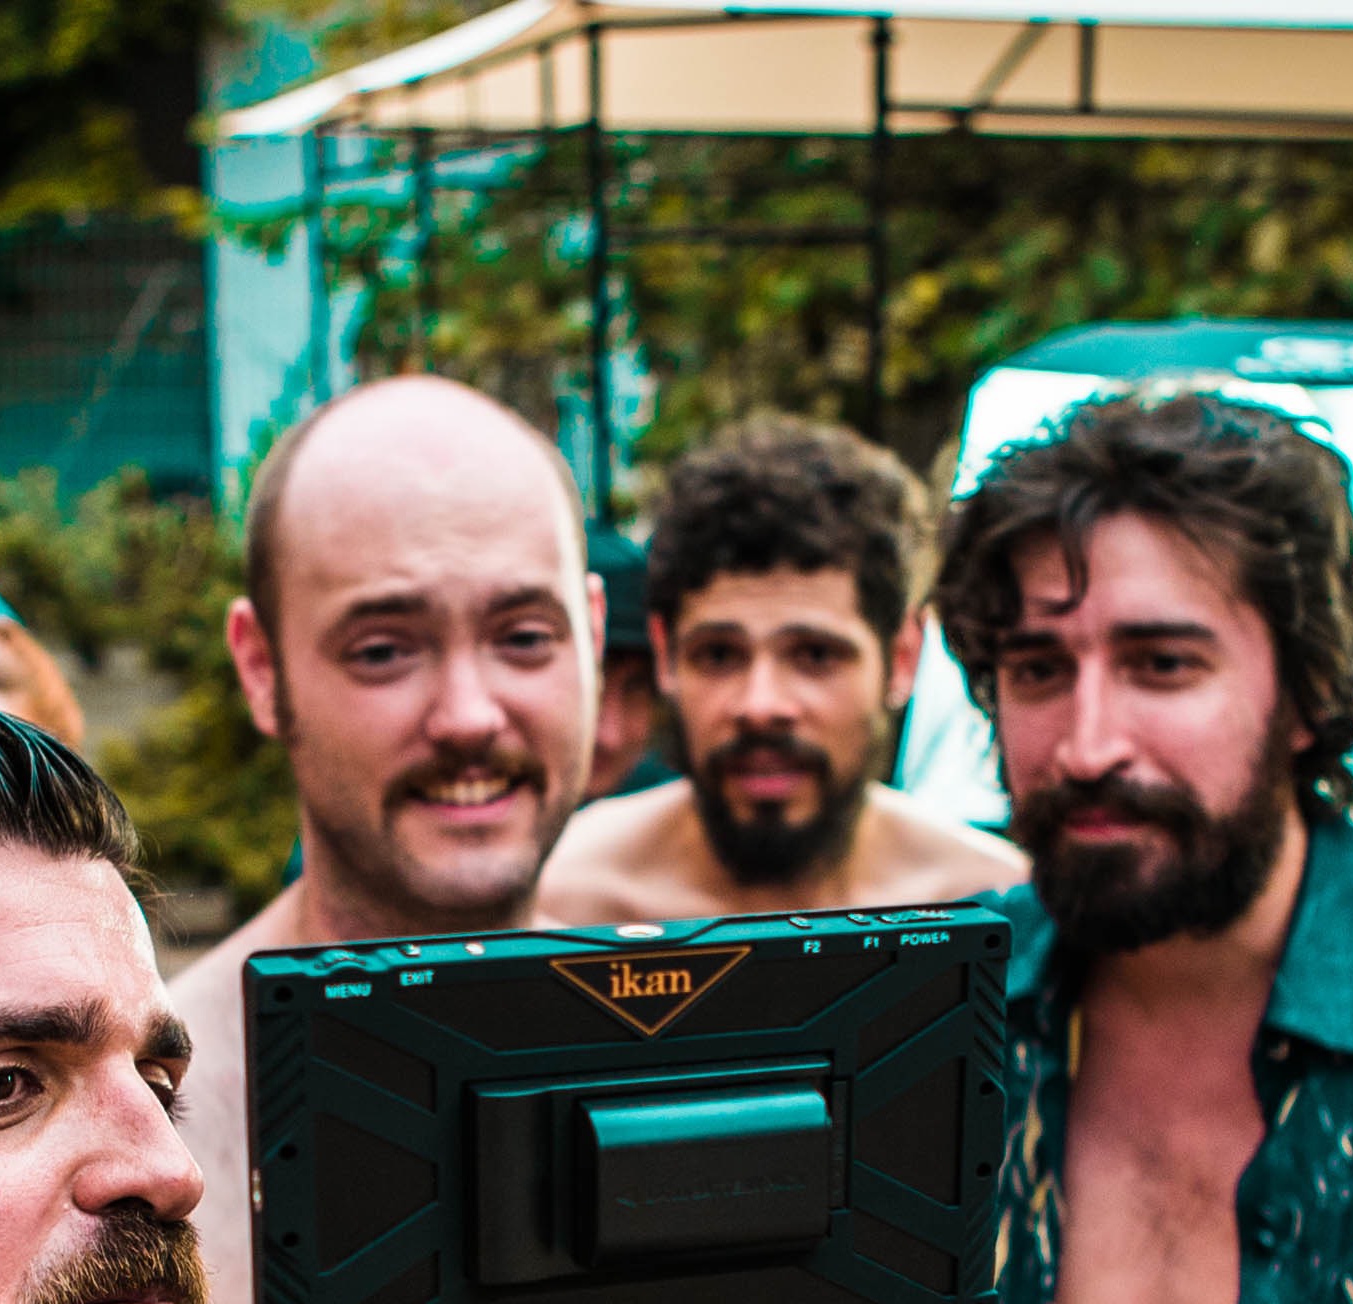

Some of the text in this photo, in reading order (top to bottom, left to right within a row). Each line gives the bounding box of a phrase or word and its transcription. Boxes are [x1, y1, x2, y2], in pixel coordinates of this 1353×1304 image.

[863, 936, 879, 949] F1
[900, 930, 950, 946] POWER
[803, 940, 821, 954] F2
[399, 969, 434, 986] EXIT
[609, 962, 692, 999] ikan
[324, 982, 372, 999] MENU
